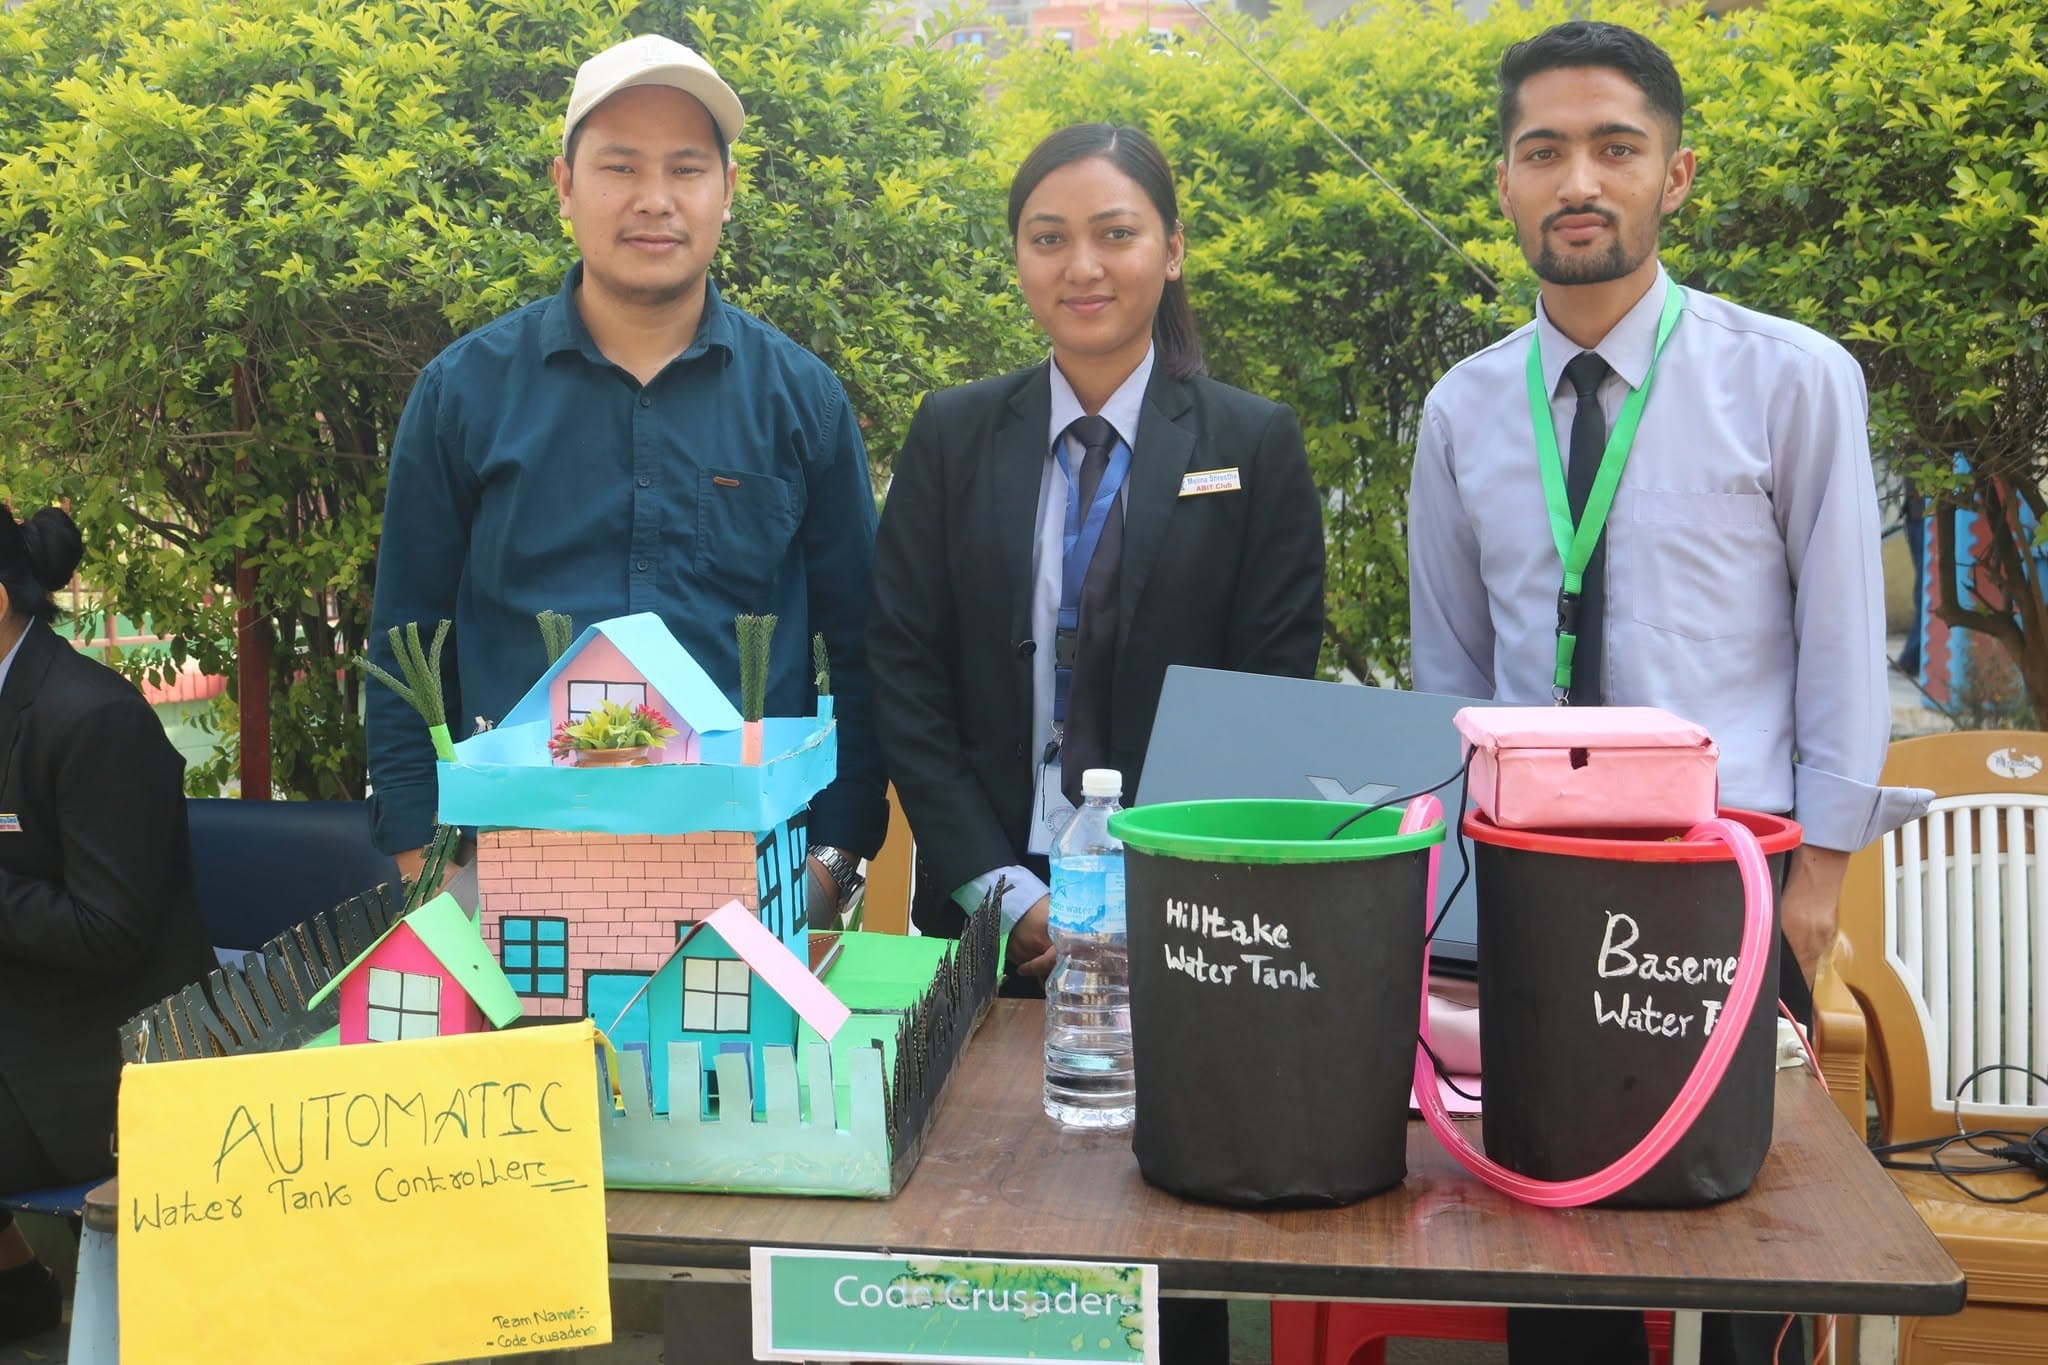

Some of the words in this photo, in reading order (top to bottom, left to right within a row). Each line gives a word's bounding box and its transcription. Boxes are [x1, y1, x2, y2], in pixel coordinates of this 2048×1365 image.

[1163, 943, 1238, 986] Water
[1240, 953, 1321, 991] Tank
[1597, 909, 1740, 985] Baseme
[1593, 990, 1695, 1037] Water
[213, 1081, 572, 1184] AUTOMATIC
[133, 1190, 243, 1233] Water
[267, 1178, 352, 1215] Tank
[833, 1274, 933, 1309] Code
[492, 1315, 532, 1329] Team
[497, 1333, 529, 1348] Code
